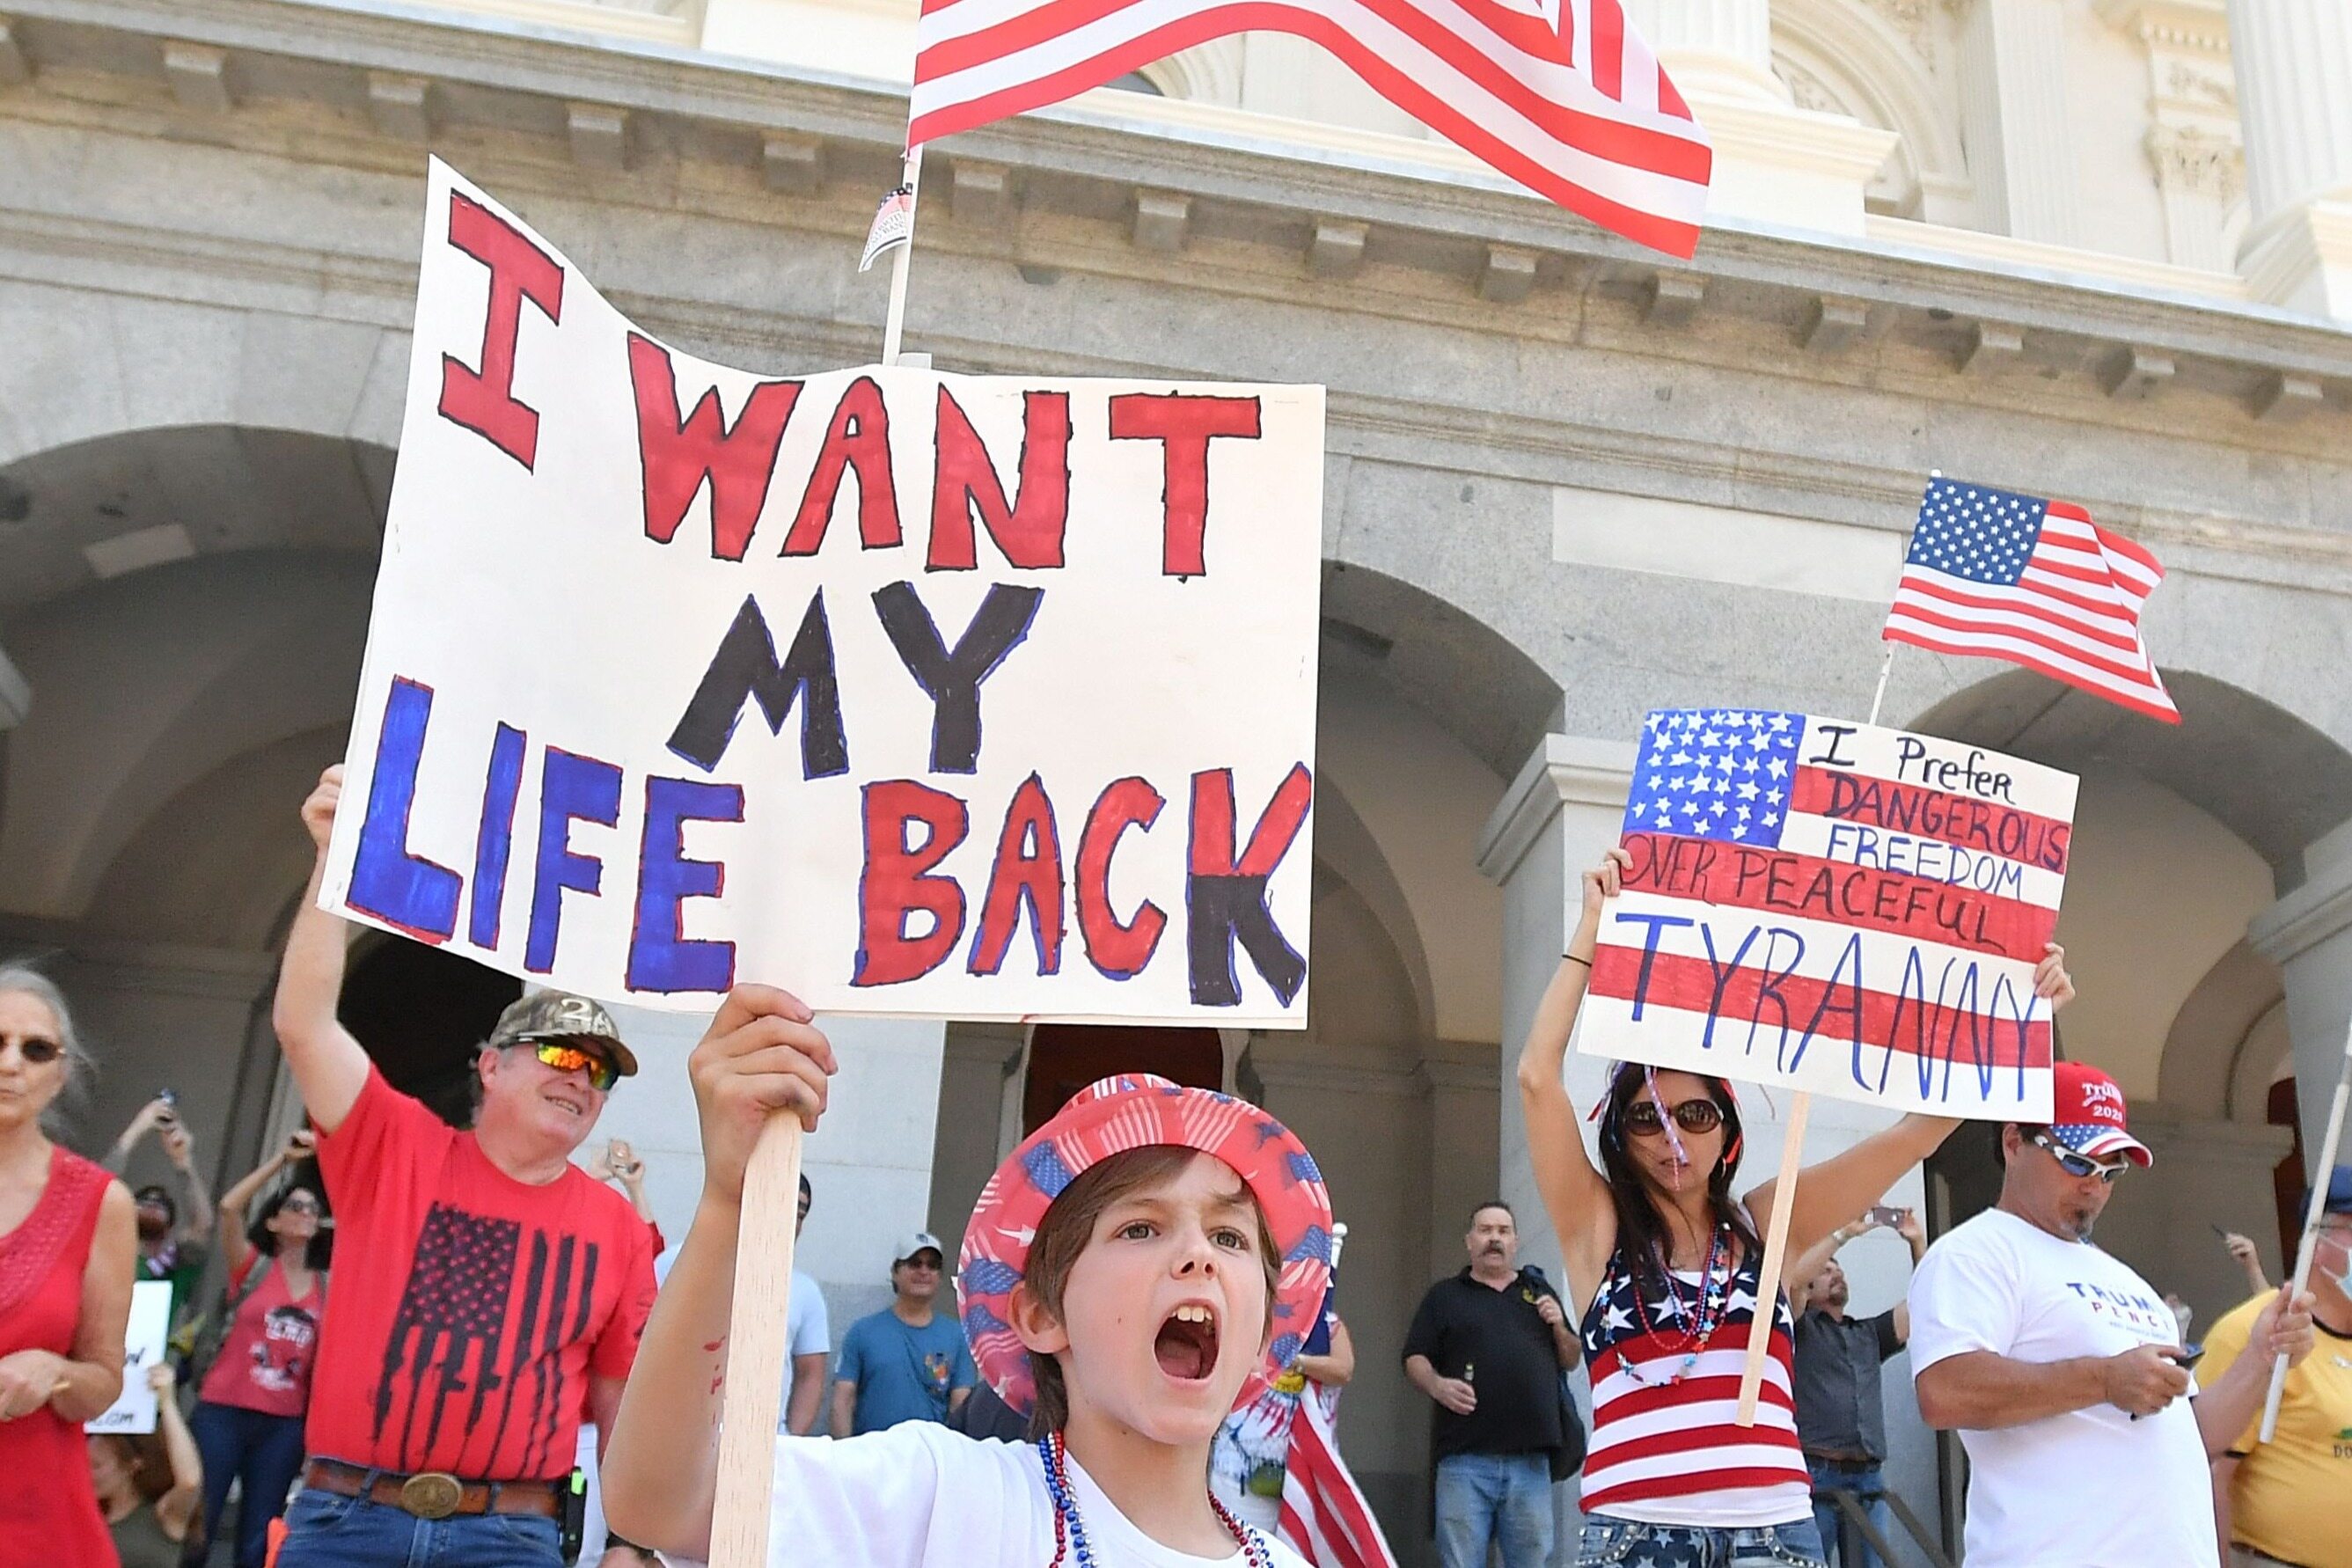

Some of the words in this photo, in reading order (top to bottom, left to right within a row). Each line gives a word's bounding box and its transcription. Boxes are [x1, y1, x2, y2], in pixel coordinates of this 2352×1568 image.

[439, 189, 563, 473] I
[626, 333, 1261, 583] WANT
[665, 581, 1044, 781] MY
[1809, 725, 1857, 767] I
[1896, 736, 2017, 805] Prefer
[1823, 769, 2070, 871] DANGEROUS
[345, 674, 744, 994] LIFE
[849, 761, 1314, 1008] BACK
[1621, 829, 1718, 909] OVER
[1733, 848, 2006, 953] PEACEFUL
[1826, 822, 2024, 901] FREEDOM
[1614, 912, 2040, 1103] TYRANNY
[2082, 1081, 2122, 1105] Tru
[2066, 1282, 2166, 1316] TRUM
